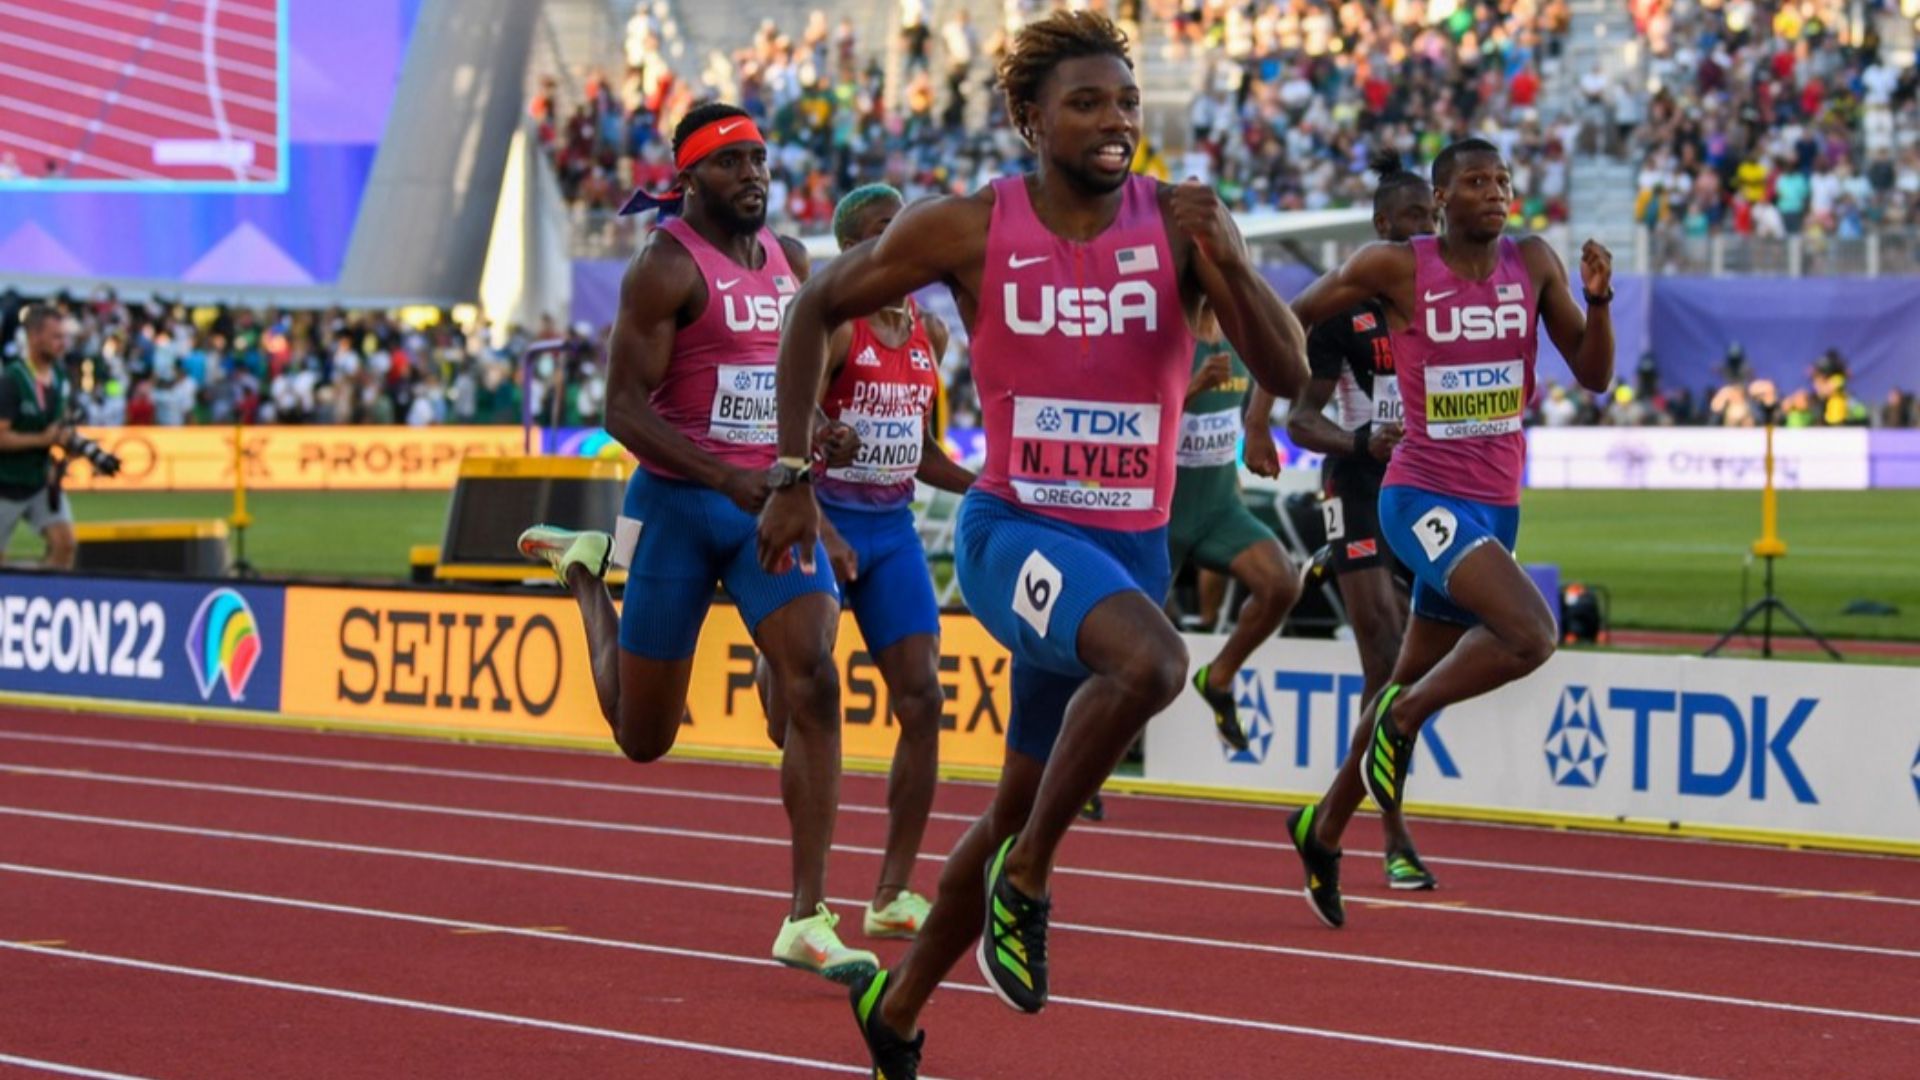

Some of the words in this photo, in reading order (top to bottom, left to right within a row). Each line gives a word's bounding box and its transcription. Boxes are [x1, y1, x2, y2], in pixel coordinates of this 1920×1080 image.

[1003, 280, 1157, 337] USA
[1426, 304, 1527, 342] USA
[751, 371, 778, 391] TD
[1458, 367, 1511, 387] TDK
[1432, 390, 1519, 417] KNIGHTON
[872, 421, 914, 439] TDK
[1063, 408, 1142, 436] TDK
[1444, 420, 1510, 436] OREGON22
[856, 443, 918, 465] GANDO
[1181, 432, 1236, 451] ADAMS
[1020, 442, 1050, 475] N.
[1063, 446, 1149, 479] LYLES
[1033, 487, 1132, 507] OREGON22
[1327, 506, 1336, 533] 2
[1426, 518, 1450, 547] 3
[1025, 572, 1051, 611] 6
[0, 595, 166, 680] EGON22
[337, 607, 563, 717] SEIKO
[1607, 688, 1821, 805] TDK
